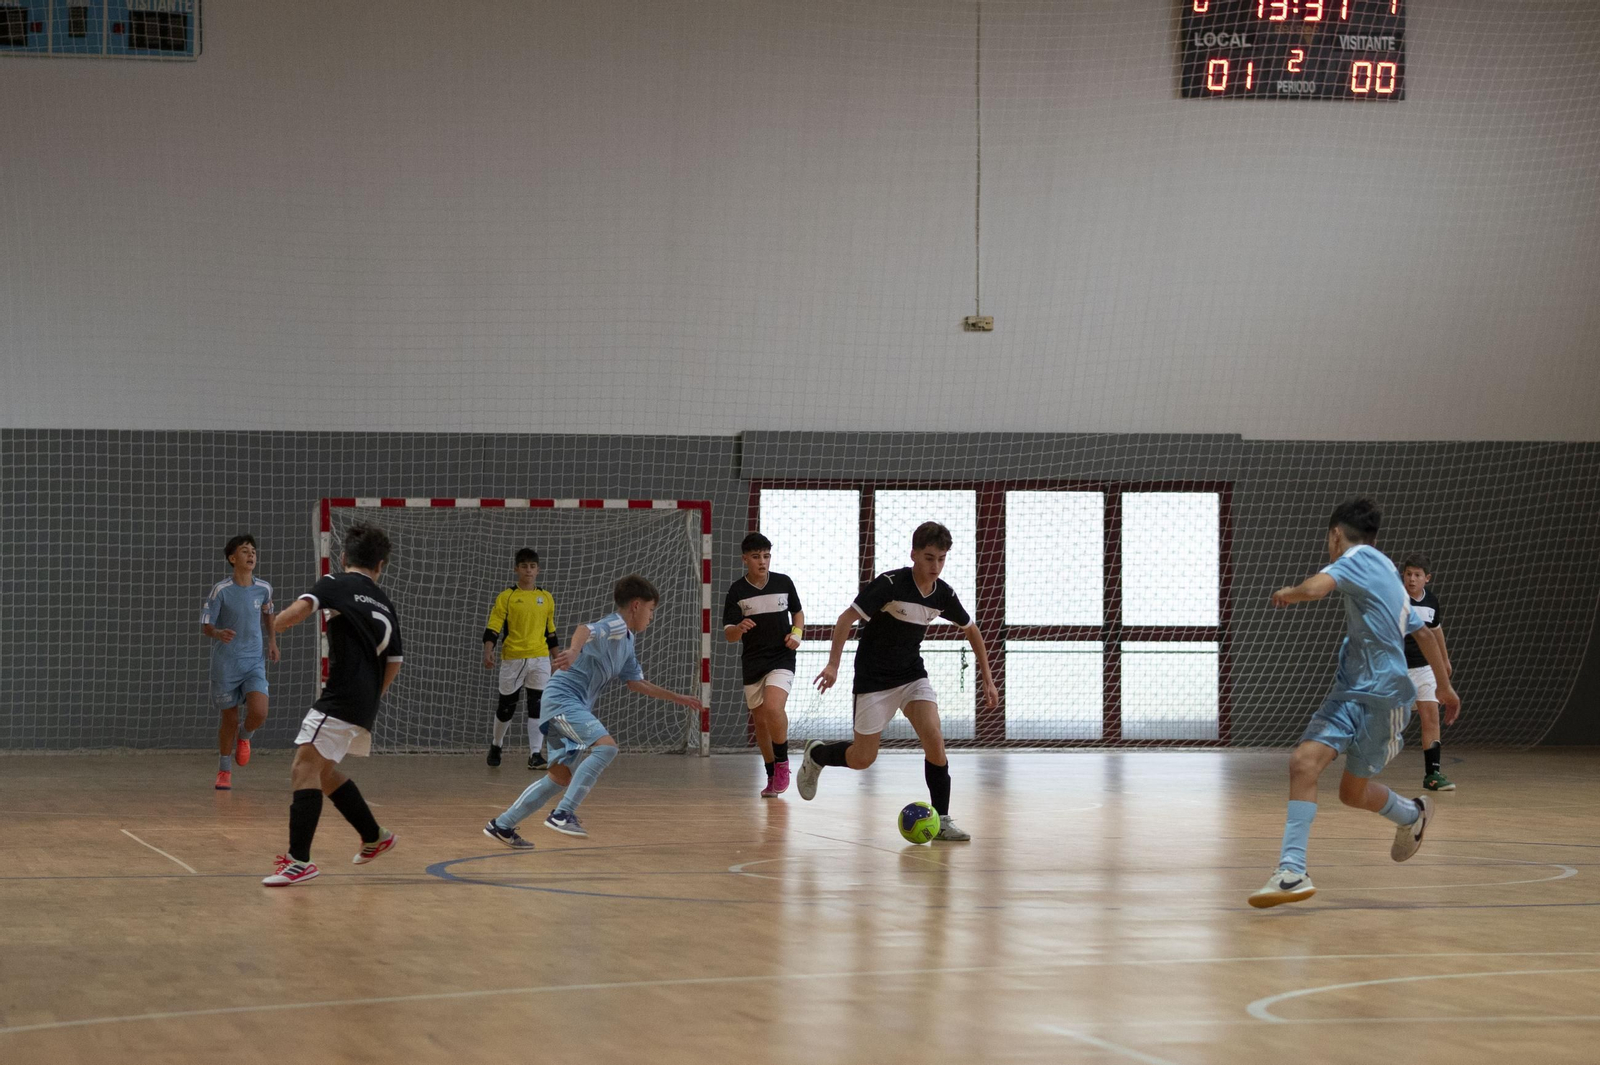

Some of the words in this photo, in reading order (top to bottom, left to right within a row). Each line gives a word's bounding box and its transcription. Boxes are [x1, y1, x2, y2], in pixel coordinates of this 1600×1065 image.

[1194, 32, 1252, 48] LOCAL
[1339, 35, 1396, 51] VISITANTE
[1287, 49, 1304, 73] 2
[1350, 61, 1397, 93] 00
[1276, 80, 1316, 93] PERIODO
